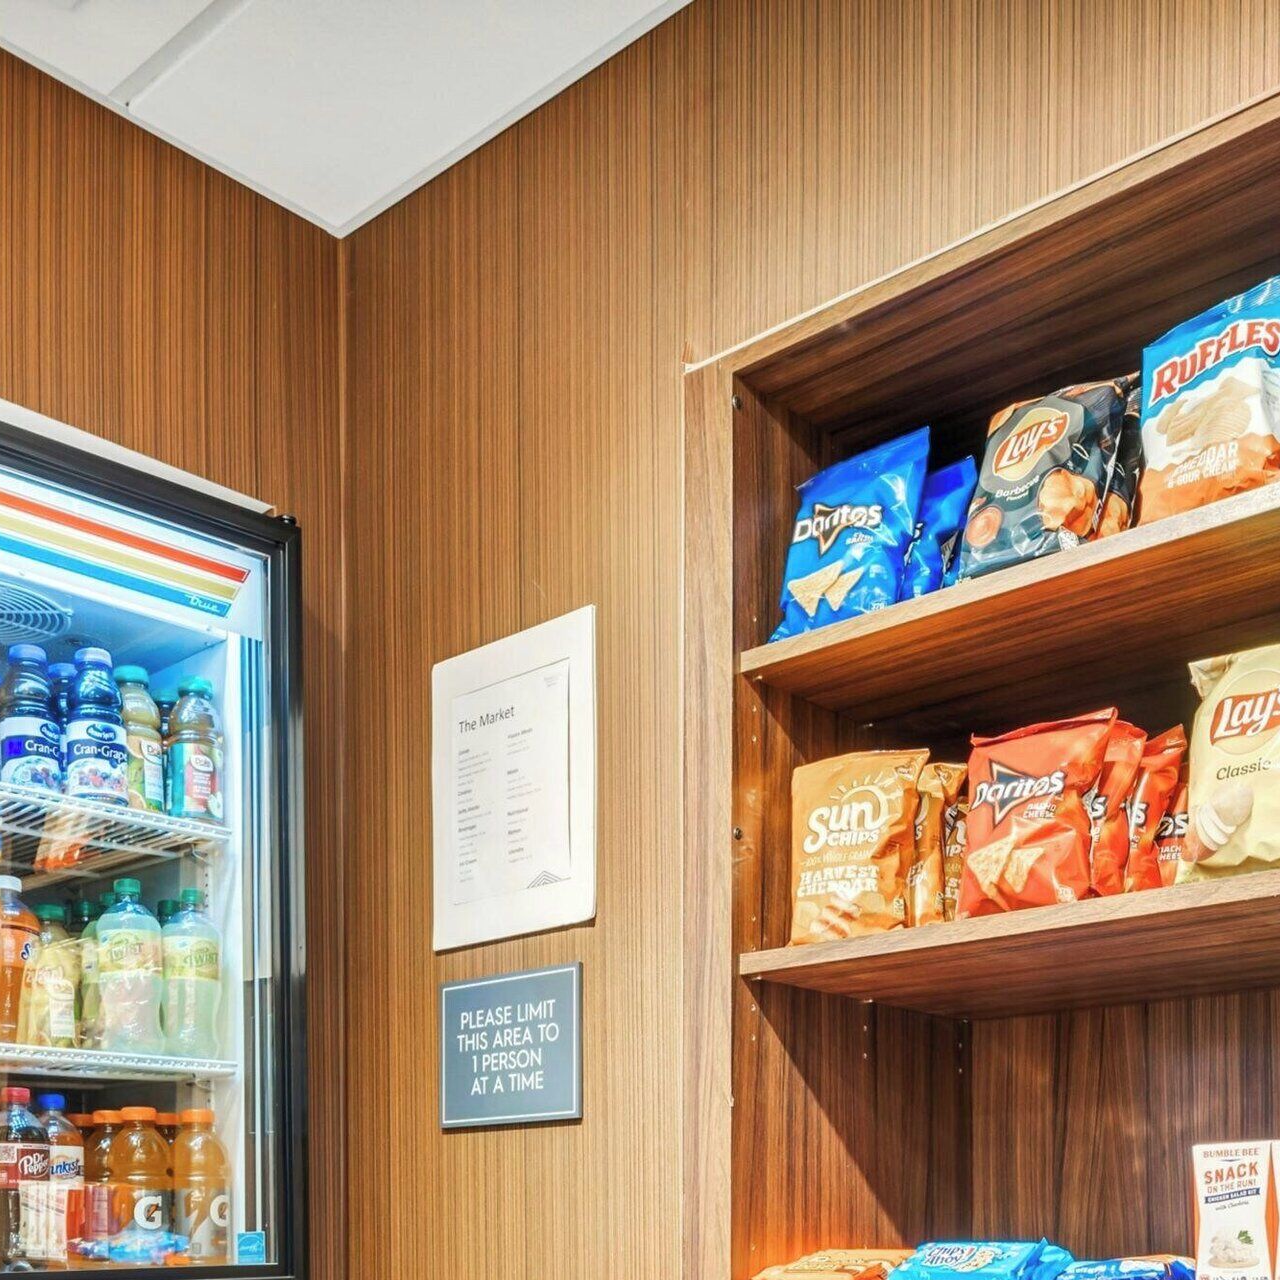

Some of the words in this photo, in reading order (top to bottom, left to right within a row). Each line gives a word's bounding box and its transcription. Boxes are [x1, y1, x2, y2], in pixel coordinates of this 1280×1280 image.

[997, 415, 1066, 470] Lay's
[994, 475, 1040, 500] Barbecue
[793, 503, 884, 545] Doritos
[459, 719, 478, 734] The
[478, 706, 516, 728] Market
[1216, 757, 1272, 782] Classic
[969, 770, 1067, 812] Doritos
[803, 801, 880, 854] Sun
[826, 830, 880, 848] CHIPS
[799, 865, 880, 885] HARVEST
[460, 1005, 512, 1030] PLEASE
[517, 999, 556, 1023] LIMIT
[457, 1031, 488, 1053] THIS
[492, 1026, 533, 1049] AREA
[538, 1022, 560, 1042] TO
[472, 1055, 478, 1073] 1
[482, 1048, 542, 1072] PERSON
[471, 1076, 489, 1096] AT
[492, 1074, 504, 1094] A
[508, 1070, 544, 1092] TIME
[1203, 1148, 1240, 1159] BUMBLE
[1242, 1147, 1260, 1157] BEE
[1204, 1161, 1259, 1185] SNACK
[1207, 1186, 1218, 1194] ON
[1220, 1183, 1235, 1191] THE
[1236, 1178, 1257, 1188] RUN!
[133, 1195, 163, 1231] G
